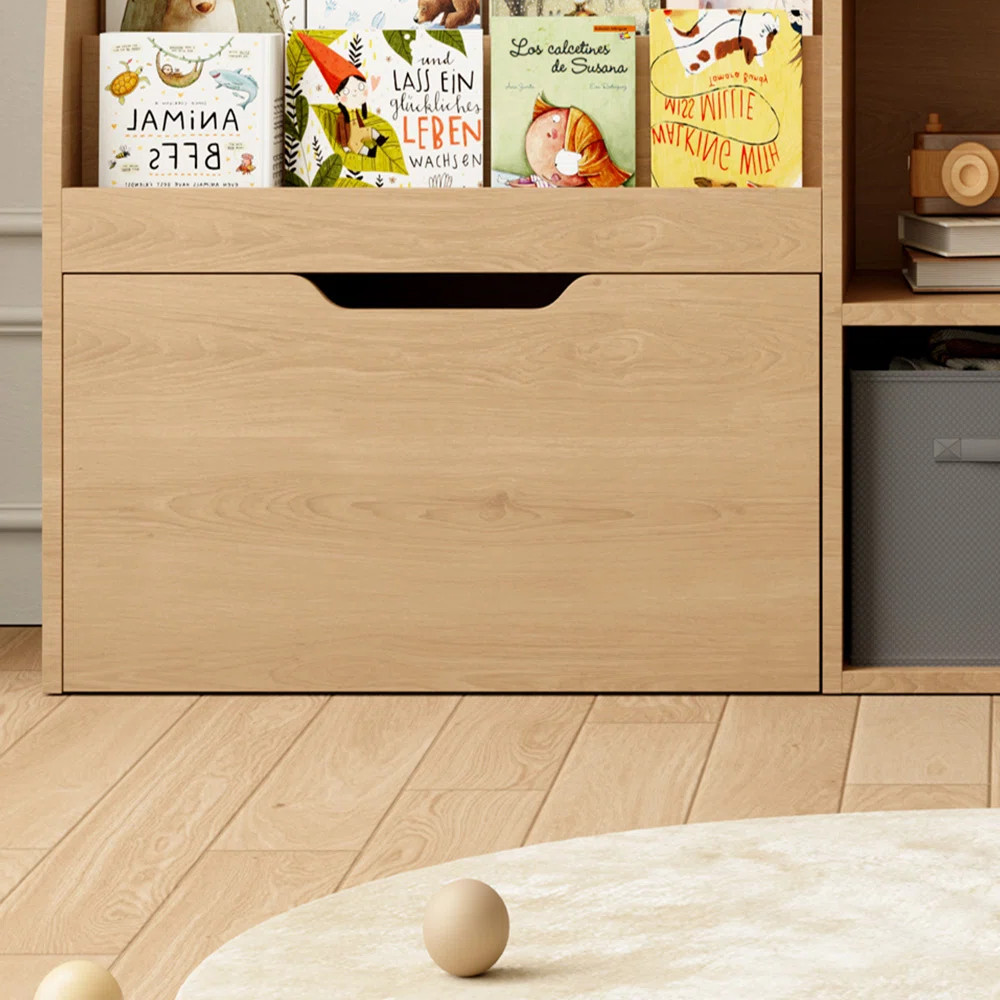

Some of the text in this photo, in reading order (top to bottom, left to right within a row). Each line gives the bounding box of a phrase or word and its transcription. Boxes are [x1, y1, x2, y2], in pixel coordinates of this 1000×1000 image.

[418, 51, 455, 65] und
[509, 38, 611, 58] Los calcetines
[551, 57, 628, 74] de Susana
[389, 90, 482, 121] glückliches
[403, 115, 481, 150] LEBEN
